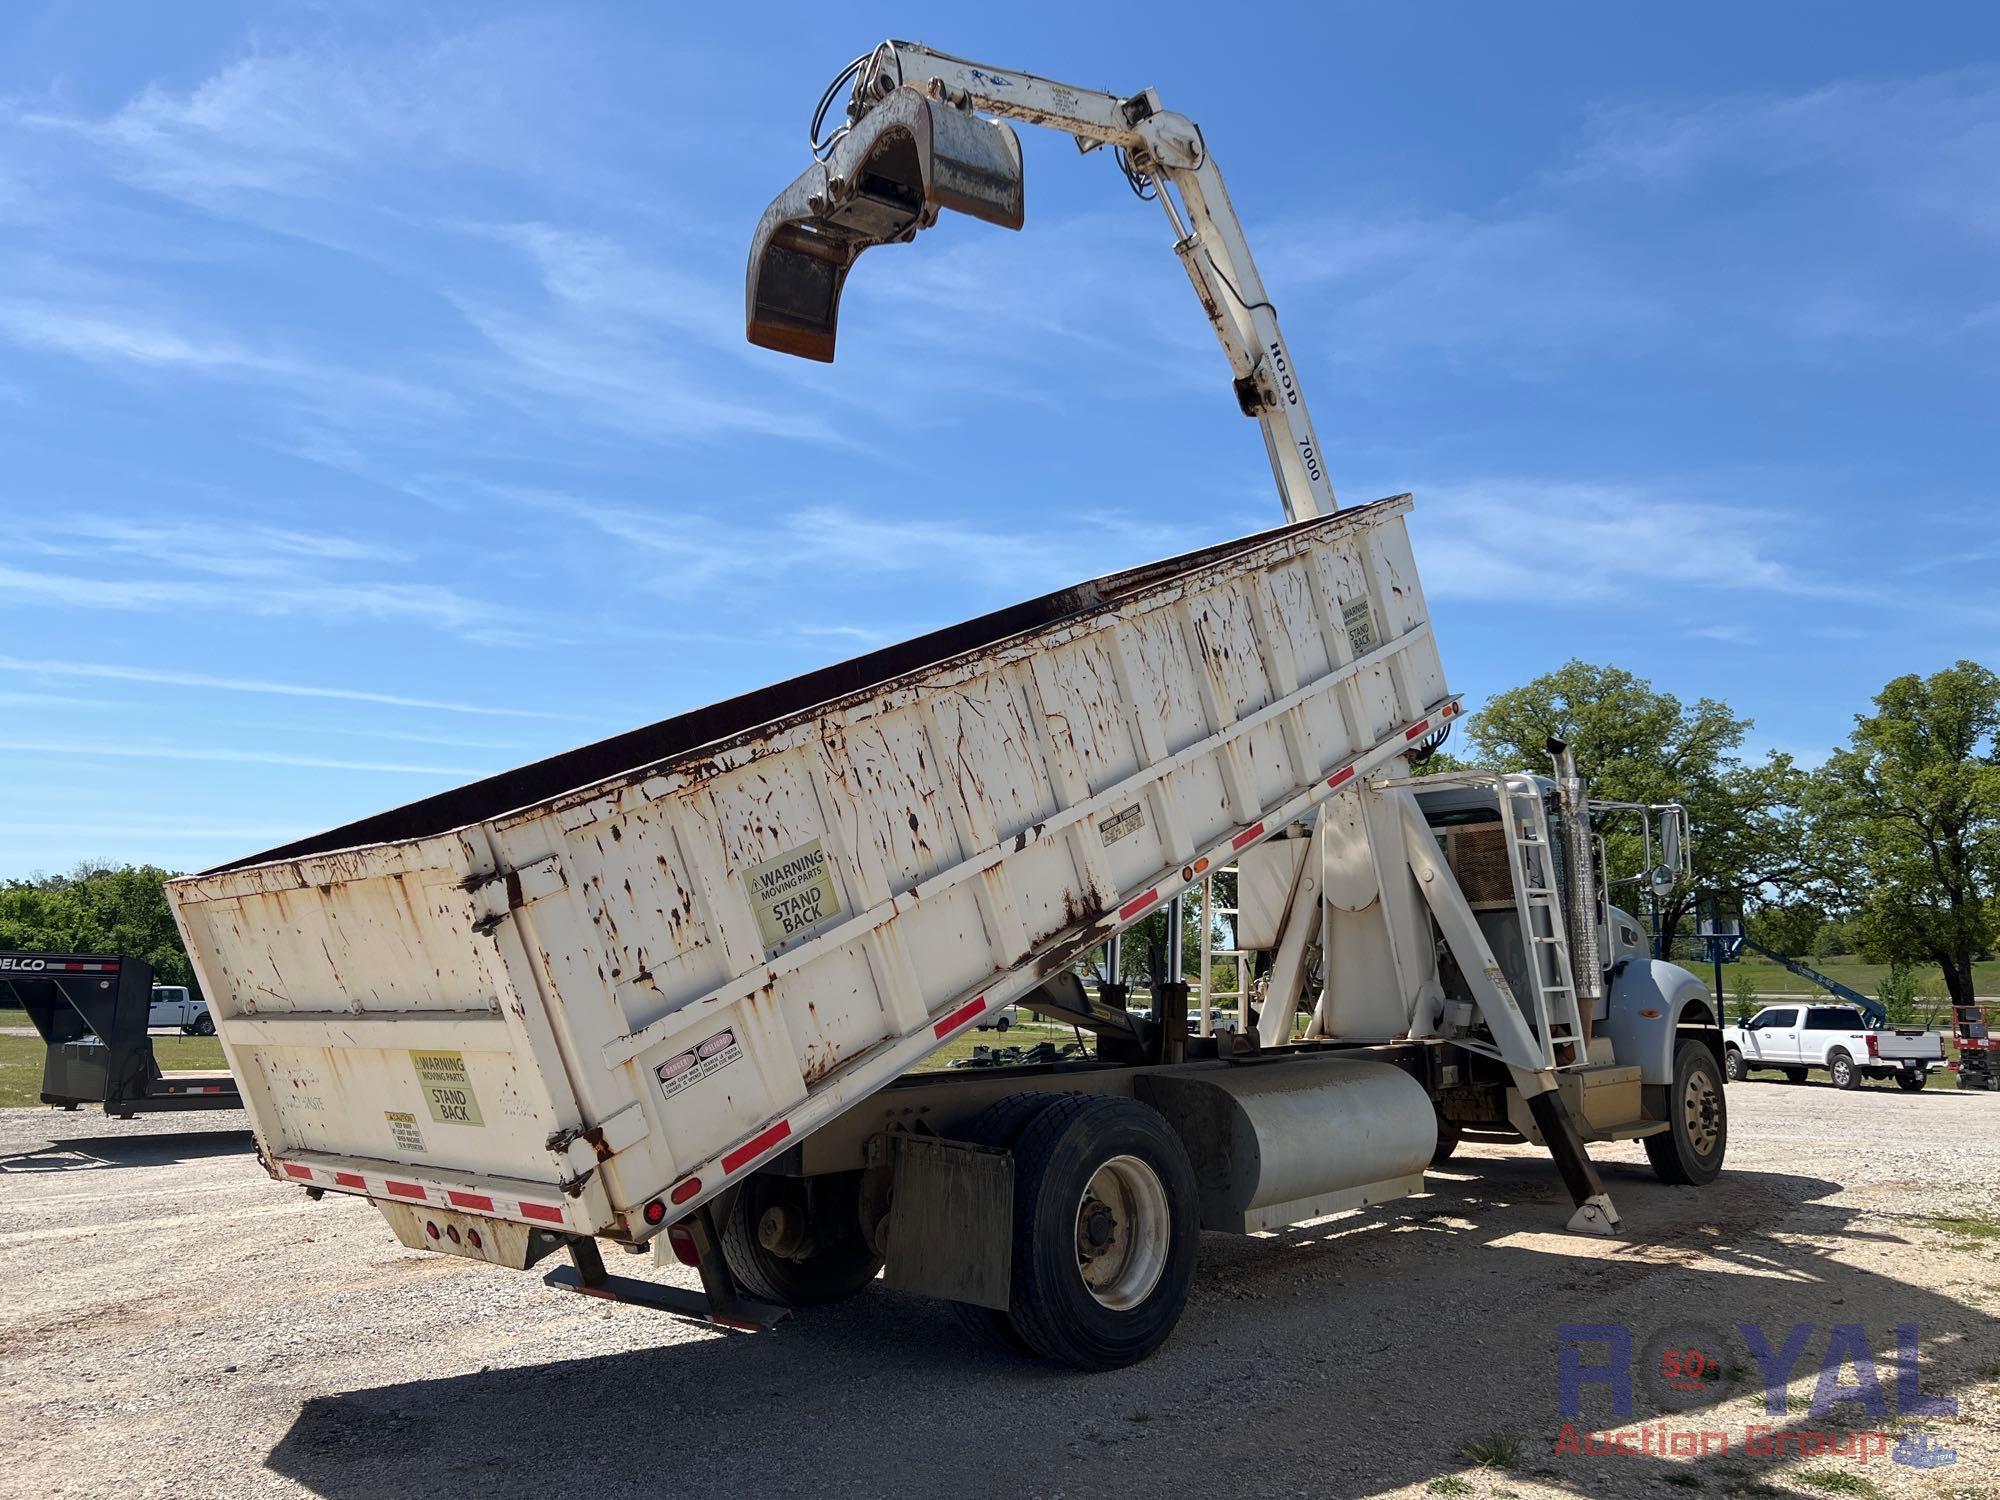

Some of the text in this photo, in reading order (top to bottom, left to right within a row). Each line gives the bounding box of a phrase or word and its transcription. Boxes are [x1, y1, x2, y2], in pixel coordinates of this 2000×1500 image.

[1270, 342, 1297, 405] HOOD
[1300, 435, 1320, 481] 7000
[1343, 600, 1368, 620] WARNING
[1349, 623, 1369, 641] STAND
[1354, 633, 1370, 649] BACK
[760, 849, 823, 888] WARNING
[761, 866, 822, 901] MOVING PARTS
[773, 887, 821, 920] STAND
[783, 903, 822, 933] BACK
[0, 958, 45, 971] ELCO
[420, 1057, 465, 1072] WARNING
[422, 1072, 465, 1082] MOVING PARTS
[432, 1089, 466, 1105] STAND
[440, 1105, 470, 1121] BACK
